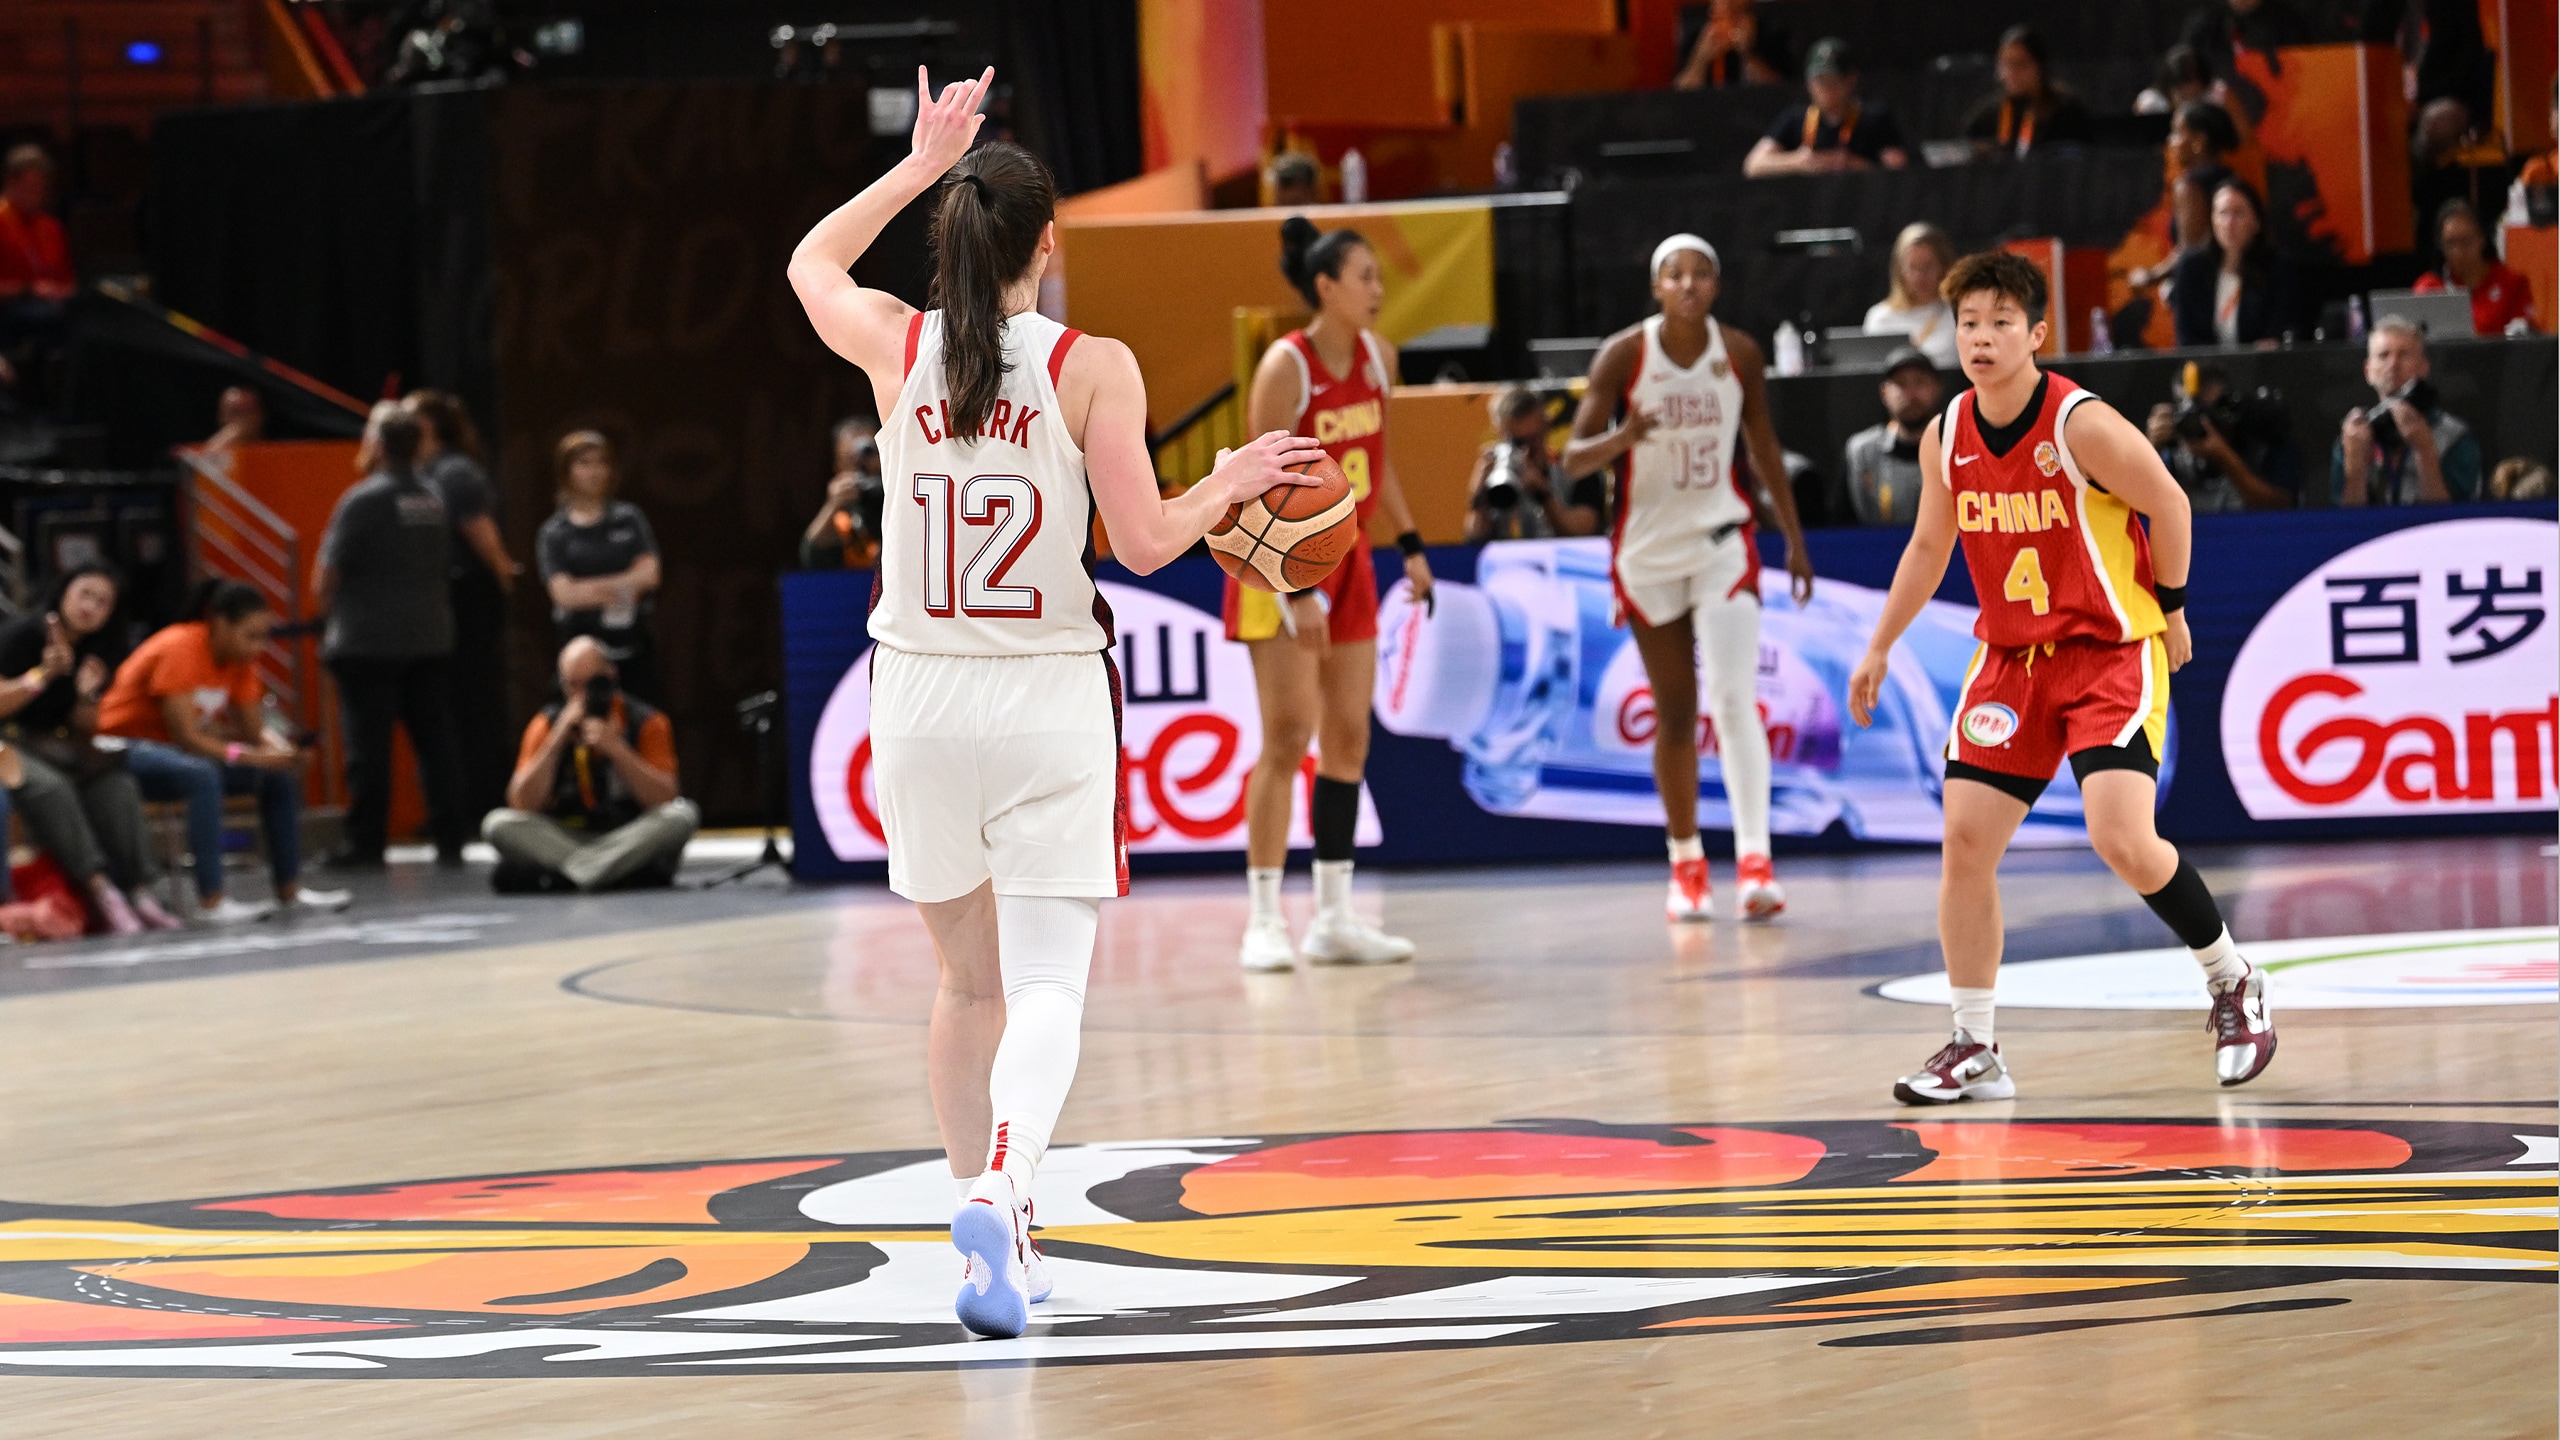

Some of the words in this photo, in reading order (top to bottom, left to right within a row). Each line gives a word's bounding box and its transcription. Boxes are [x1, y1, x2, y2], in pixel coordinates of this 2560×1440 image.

[1314, 397, 1382, 445] CHINA
[1664, 389, 1723, 429] USA
[1341, 446, 1371, 502] 9
[1669, 436, 1720, 490] 15
[1956, 488, 2070, 533] CHINA
[912, 473, 1043, 619] 12
[2003, 546, 2050, 616] 4
[2324, 566, 2546, 666] 百岁
